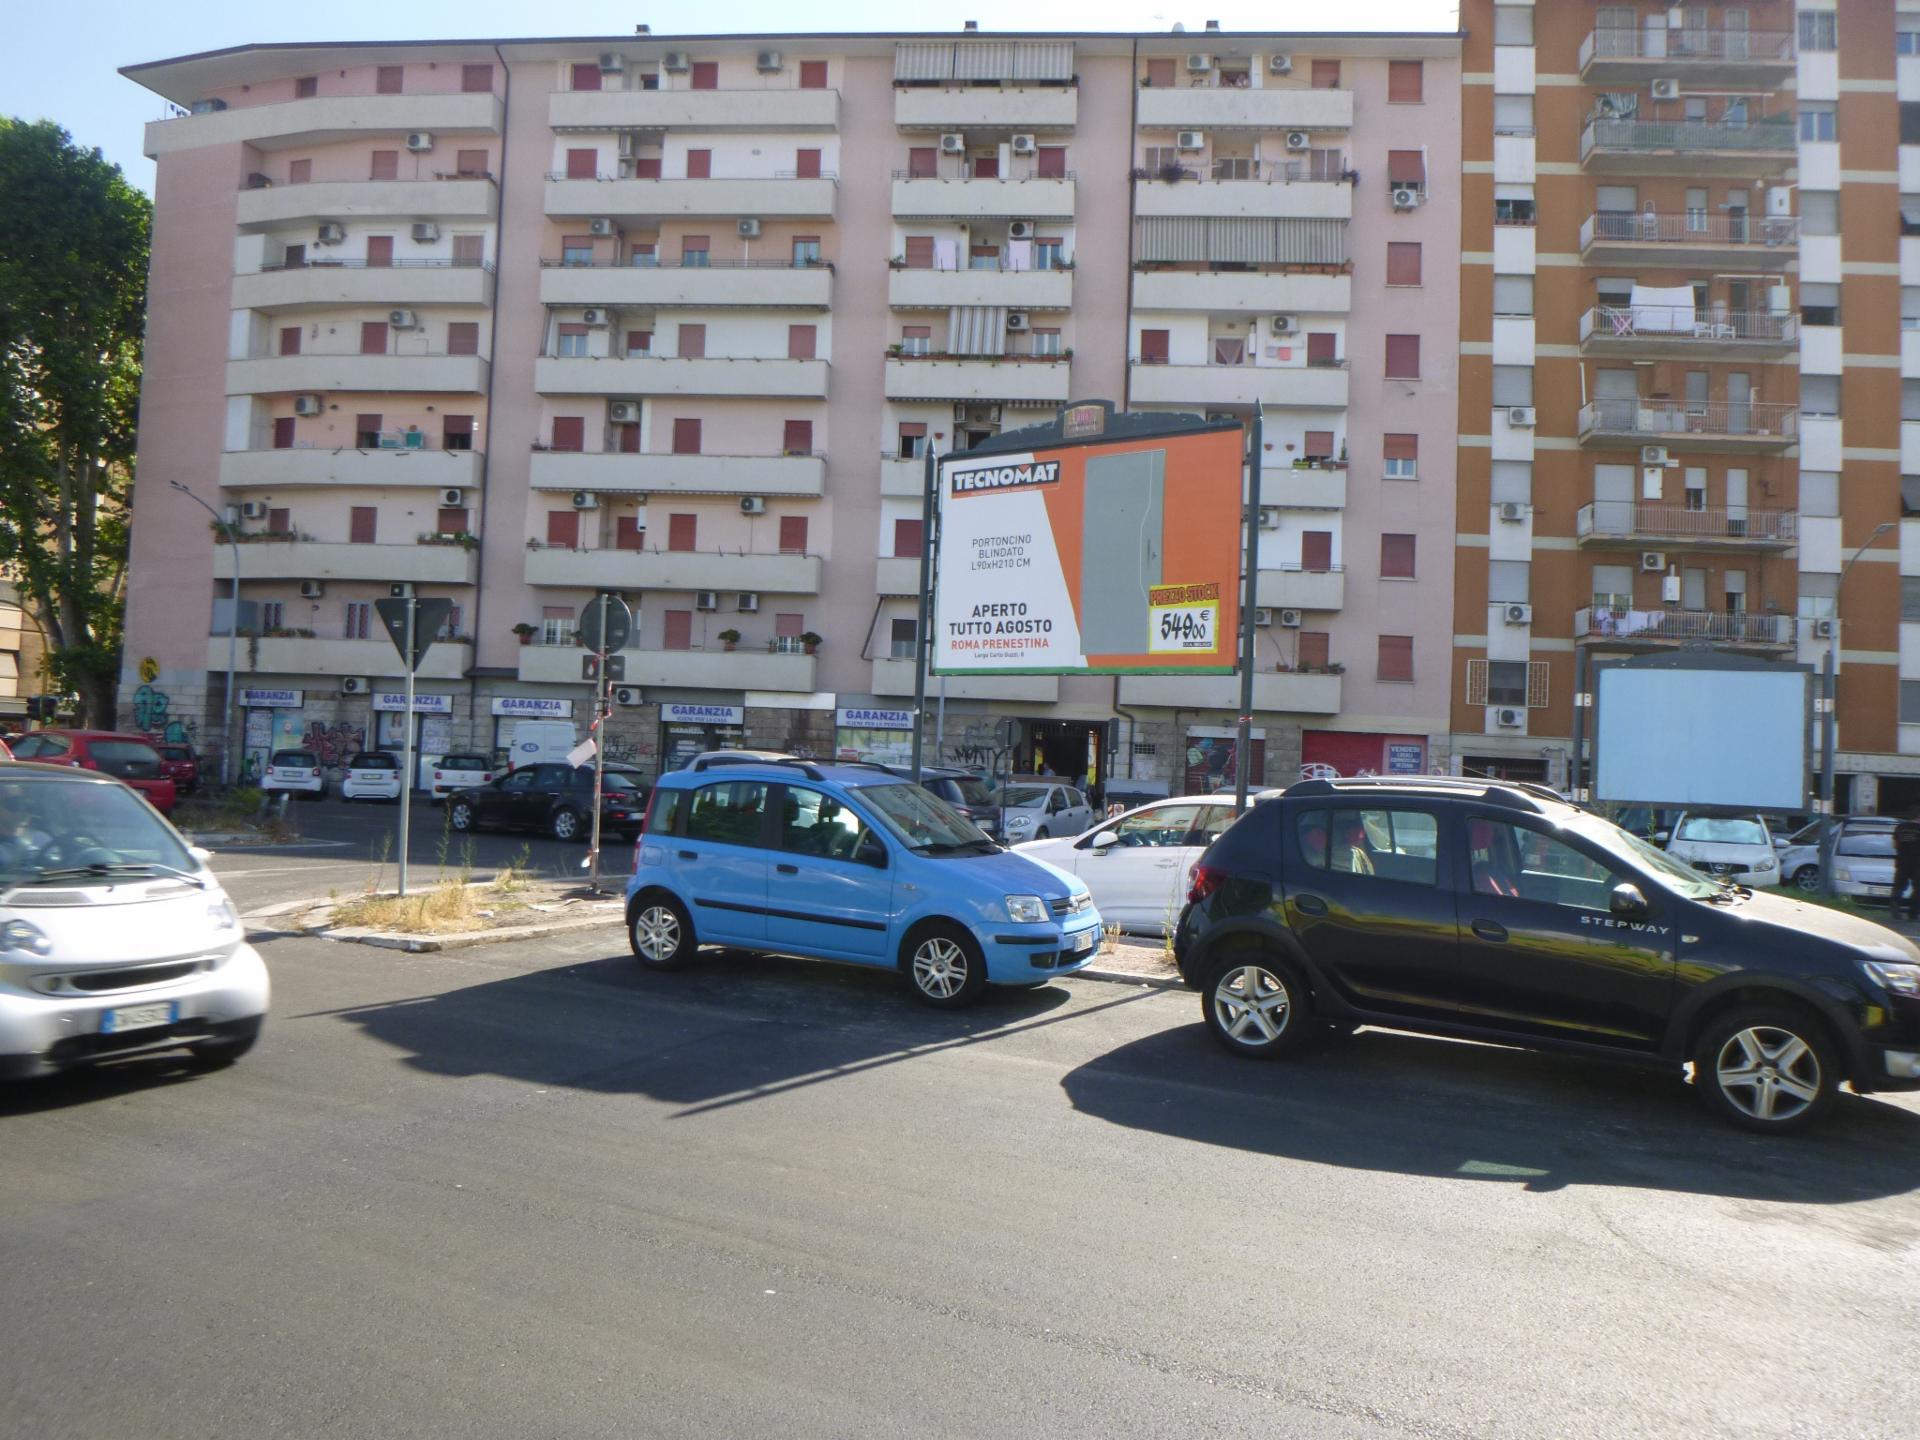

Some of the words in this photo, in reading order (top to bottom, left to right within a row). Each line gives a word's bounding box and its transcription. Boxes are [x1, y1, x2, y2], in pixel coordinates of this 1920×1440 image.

[954, 463, 1058, 491] TECNOMAT
[972, 534, 1032, 548] PORTONCINO
[979, 546, 1024, 559] BLINDATO
[1016, 558, 1031, 568] CM
[972, 602, 1027, 618] APERTO
[949, 621, 992, 636] TUTTO
[995, 619, 1052, 634] AGOSTO
[951, 639, 980, 650] ROMA
[982, 638, 1050, 649] PRENESTINA
[384, 695, 442, 705] GARNZIA
[502, 700, 561, 710] GARANZIA
[672, 705, 733, 717] GARANZIA
[846, 710, 908, 722] GARANZIA
[1580, 916, 1670, 935] STEPWAY
